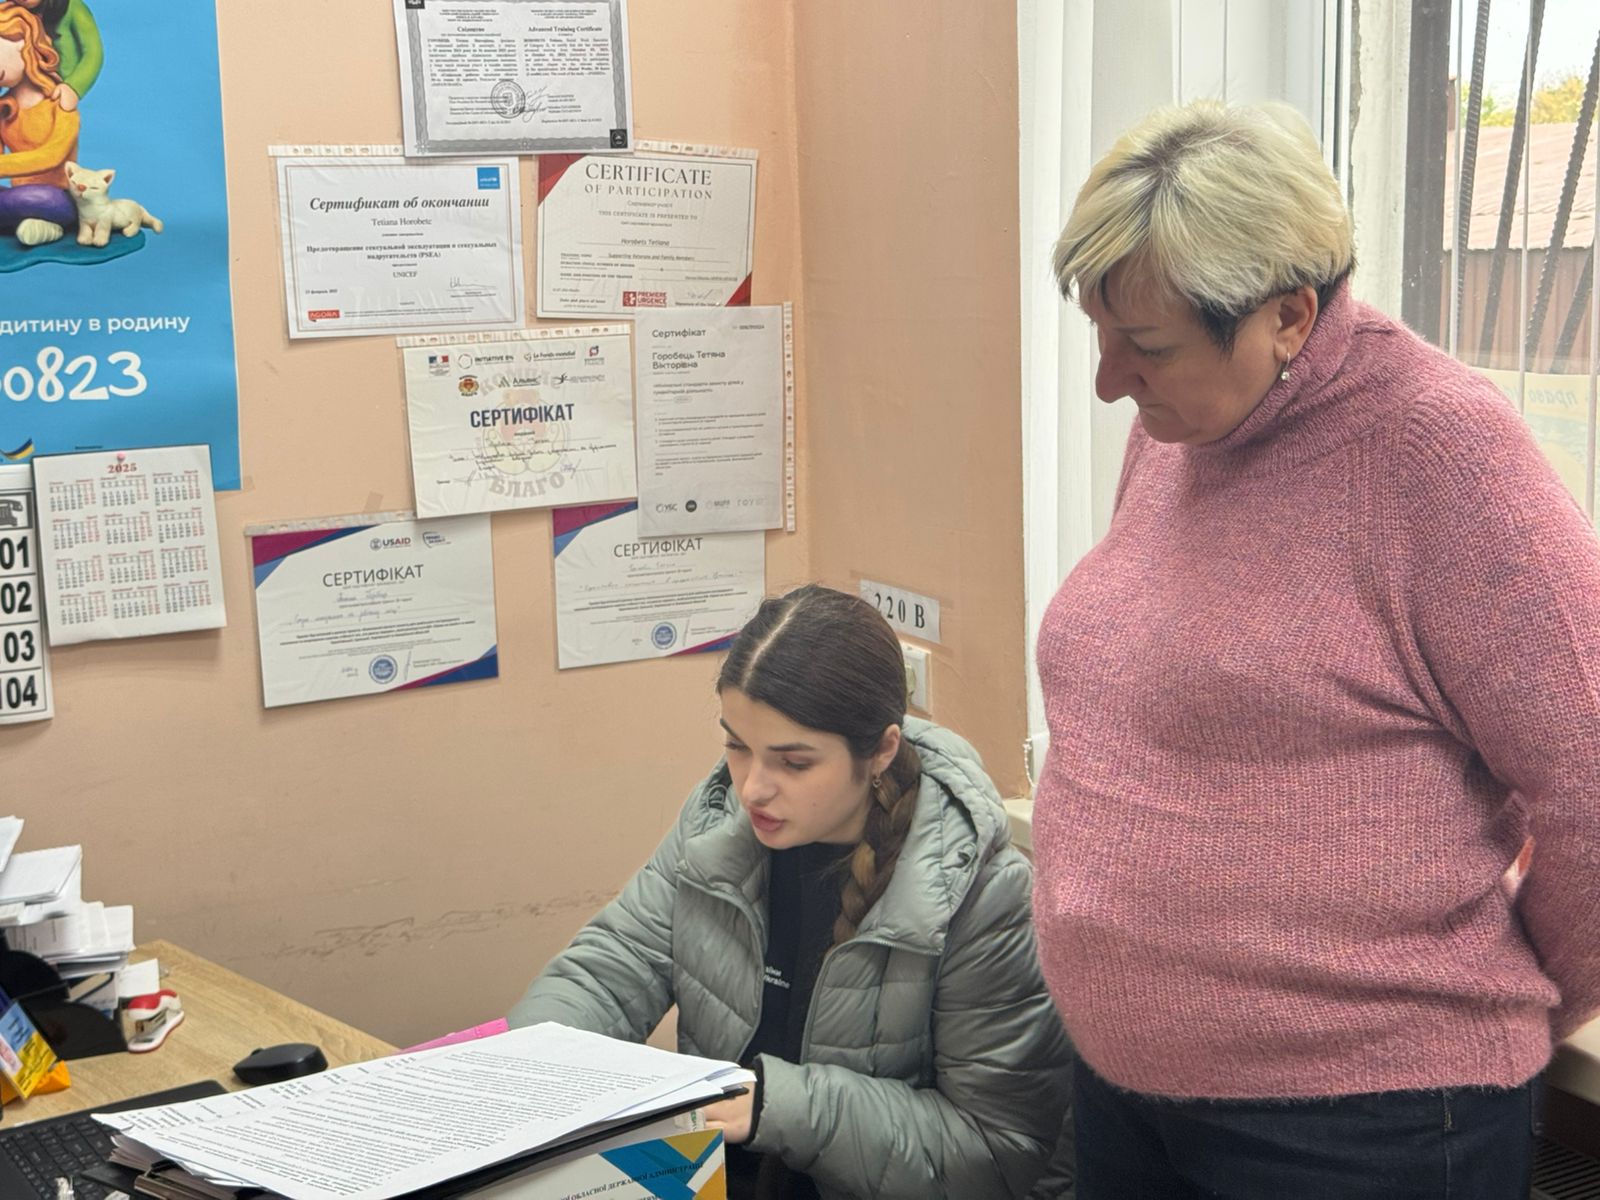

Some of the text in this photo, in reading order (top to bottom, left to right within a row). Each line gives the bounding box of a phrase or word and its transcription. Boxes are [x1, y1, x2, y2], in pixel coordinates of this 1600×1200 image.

[585, 163, 712, 186] CERTIFICATE
[584, 184, 712, 200] OF PARTICIPATION
[309, 196, 489, 213] Сертификат об окончании
[371, 217, 397, 226] Tetiana
[306, 245, 364, 254] Предотвращение
[365, 243, 405, 251] сексуальной
[407, 243, 451, 251] эксплуатации
[457, 241, 497, 250] сексуальных
[419, 251, 441, 259] (PSEA)
[393, 270, 417, 278] UNICEF
[310, 311, 338, 319] AGORA
[0, 316, 190, 336] дитину в родину
[652, 328, 706, 338] Сертифікат
[652, 350, 726, 361] Горобець Тетяна
[0, 346, 147, 402] 0823
[652, 361, 698, 370] Вікторівна
[470, 403, 575, 428] СЕРТИФІКАТ
[107, 463, 137, 473] 2025
[488, 471, 566, 498] БЛАГО
[382, 537, 411, 547] USAID
[613, 537, 703, 559] СЕРТИФІКАТ
[0, 536, 29, 570] 01
[322, 564, 424, 588] СЕРТИФІКАТ
[0, 581, 32, 615] 02
[874, 592, 925, 629] 220 В
[4, 630, 35, 664] 03
[0, 675, 38, 709] 04
